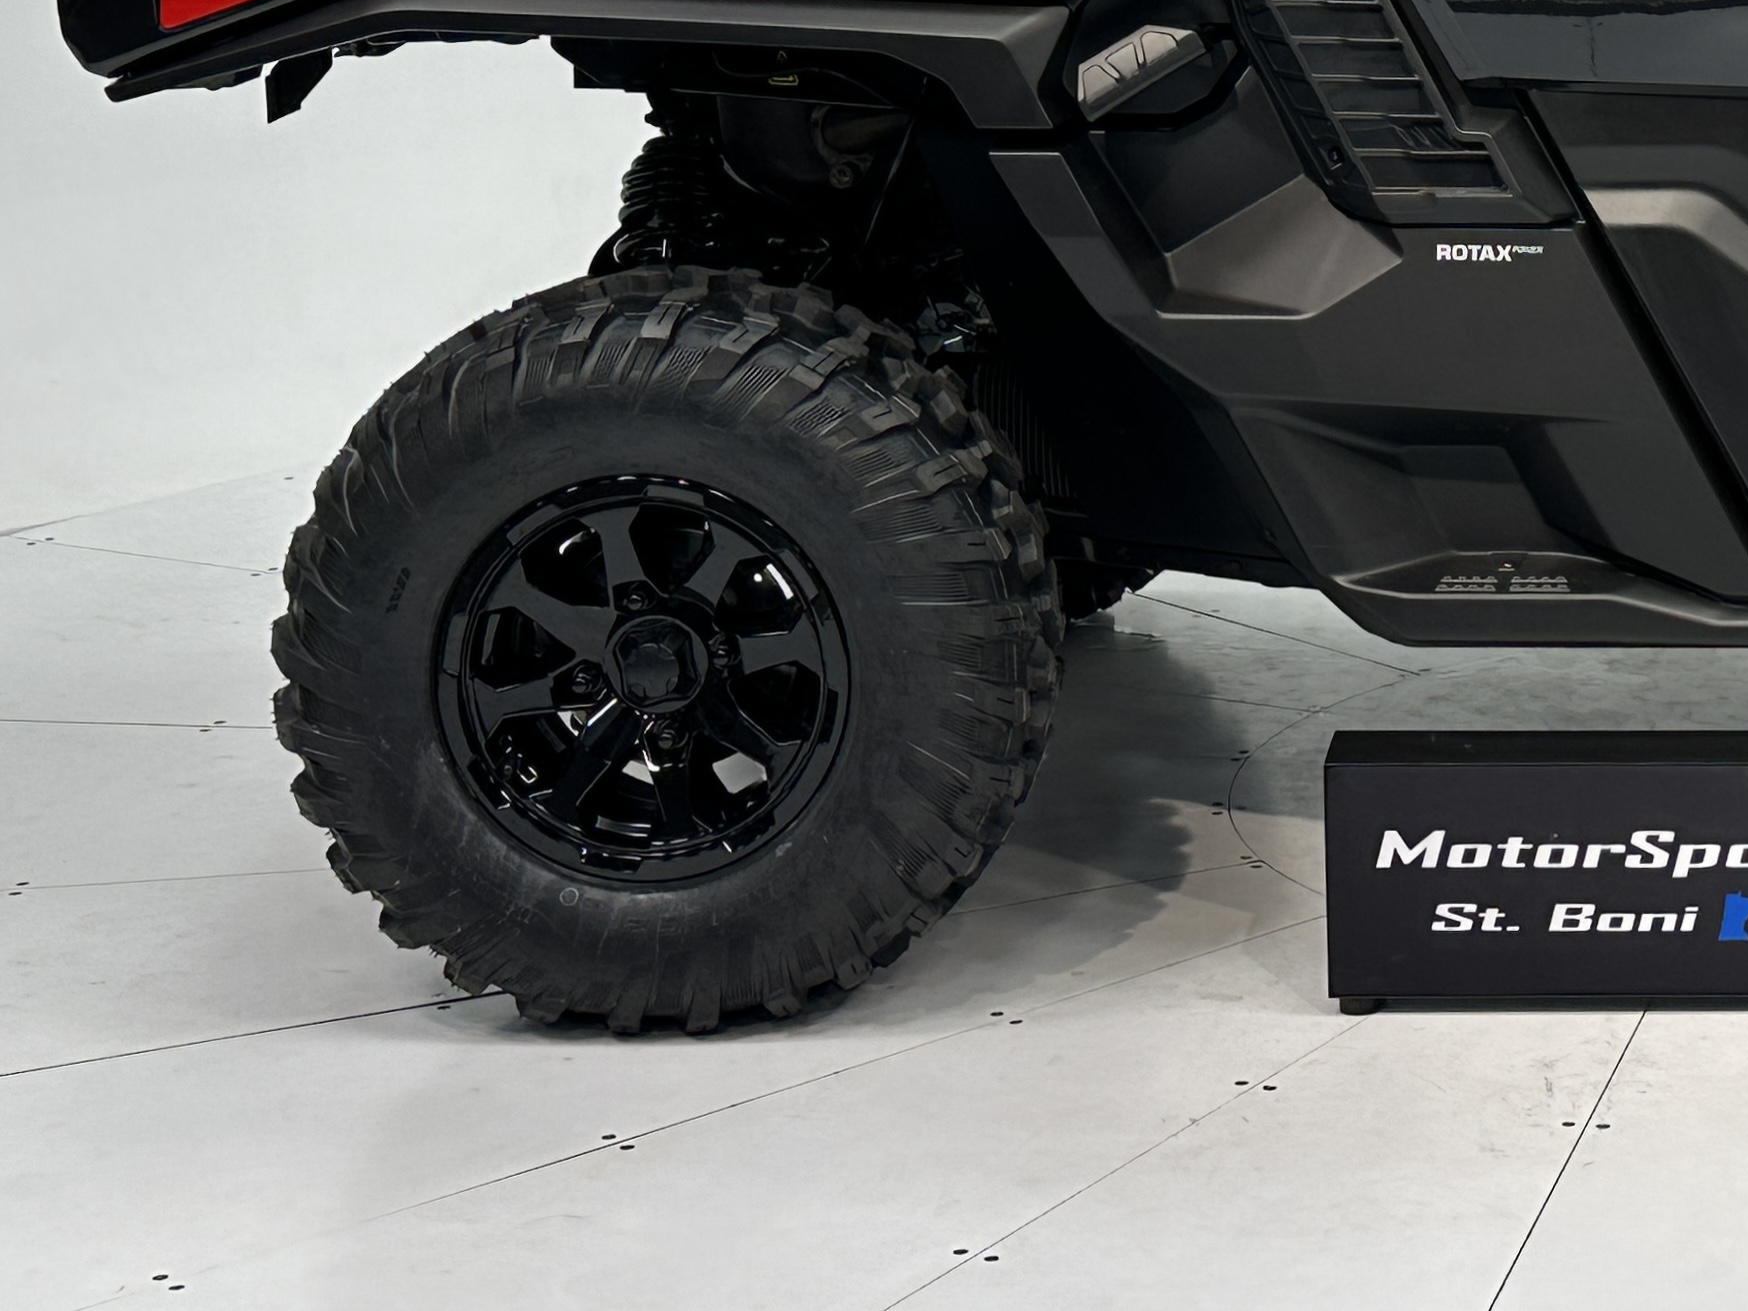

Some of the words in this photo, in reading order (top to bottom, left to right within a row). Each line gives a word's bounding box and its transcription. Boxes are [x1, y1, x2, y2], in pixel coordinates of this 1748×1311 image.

[1436, 244, 1512, 262] ROTAX
[1432, 904, 1519, 931] St.
[1549, 904, 1698, 931] Boni
